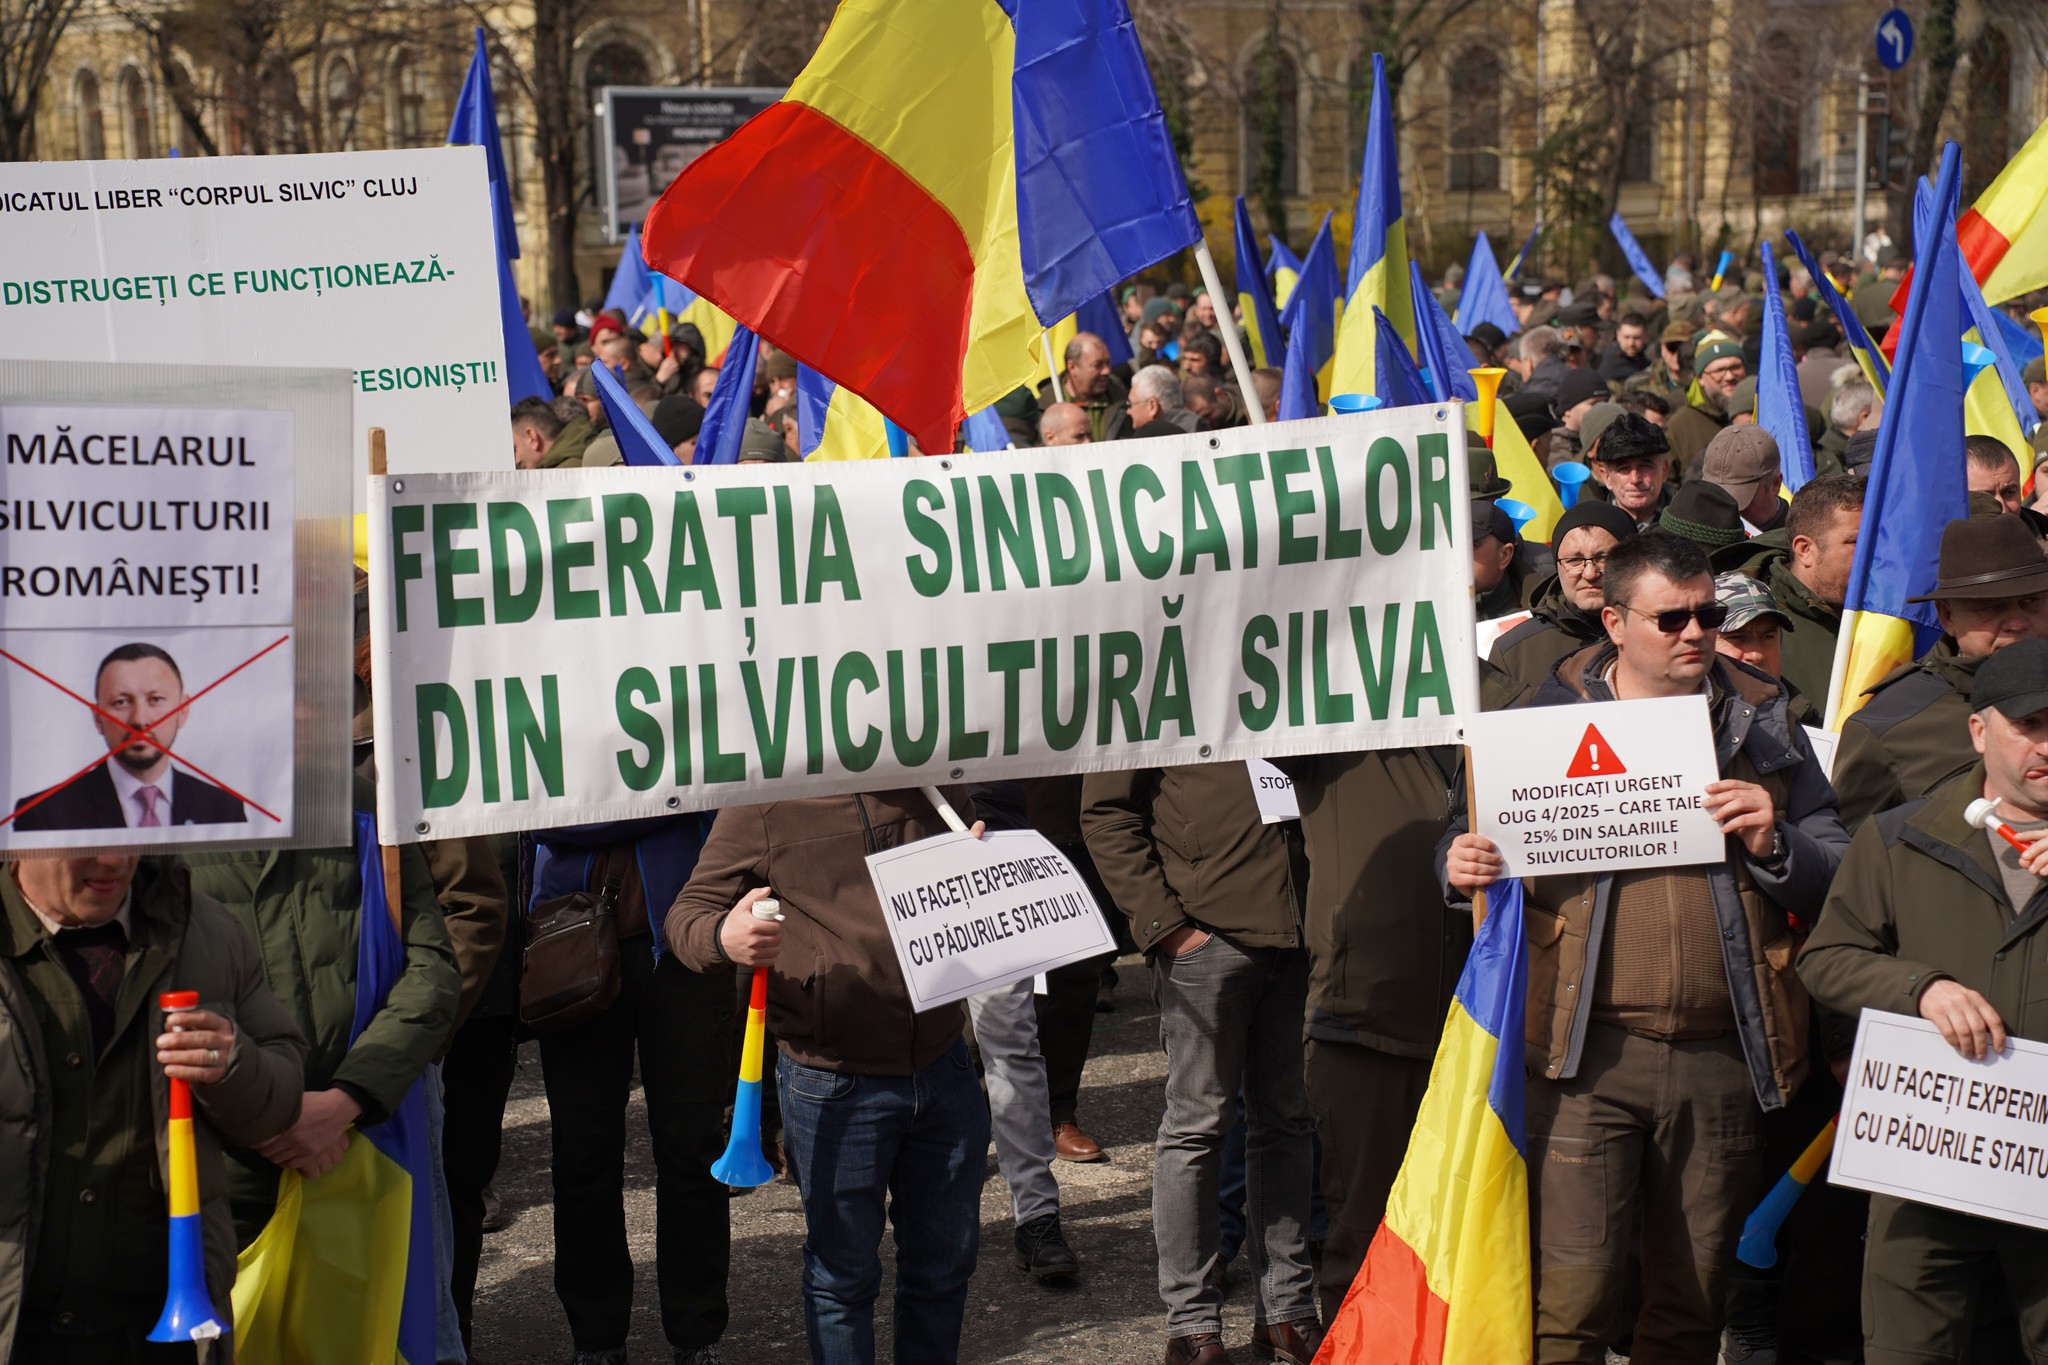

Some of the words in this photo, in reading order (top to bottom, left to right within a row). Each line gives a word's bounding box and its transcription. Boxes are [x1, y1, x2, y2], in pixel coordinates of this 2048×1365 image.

[0, 191, 88, 212] ICATUL
[95, 188, 163, 210] LIBER
[363, 177, 418, 198] CLUJ
[3, 275, 177, 306] DISTRUGEȚI
[188, 272, 225, 297] CE
[234, 254, 455, 297] FUNCȚIONEAZĂ-
[6, 425, 255, 467] MĂCELARUL
[391, 484, 862, 657] FEDERAȚIA
[903, 432, 1453, 598] SINDICATELOR
[415, 674, 566, 810] DIN
[615, 594, 1196, 792] SILVICULTURĂ
[1237, 600, 1455, 733] SILVA
[1260, 776, 1293, 790] STOP
[1512, 780, 1610, 802] MODIFICAȚI
[1615, 774, 1683, 794] URGENT
[1498, 809, 1537, 825] OUG
[1541, 804, 1599, 824] 4/2025
[1619, 798, 1662, 815] CARE
[1667, 795, 1702, 811] TAIE
[1523, 829, 1558, 845] 25%
[1563, 826, 1592, 842] DIN
[1598, 819, 1679, 839] SALARIILE
[1527, 842, 1667, 865] SILVICULTORILOR
[1673, 840, 1678, 855] !
[891, 891, 917, 922] NU
[916, 873, 974, 913] FACEȚI
[971, 854, 1069, 896] EXPERIMENTE
[909, 936, 934, 966] CU
[933, 912, 1014, 959] PĂDURILE
[1012, 893, 1081, 934] STATULUI
[1861, 1058, 1891, 1091] NU
[1894, 1065, 1965, 1114] FACEȚI
[1854, 1111, 1883, 1142] CU
[1885, 1113, 1986, 1165] PĂDURILE
[1989, 1139, 2048, 1179] STATU
